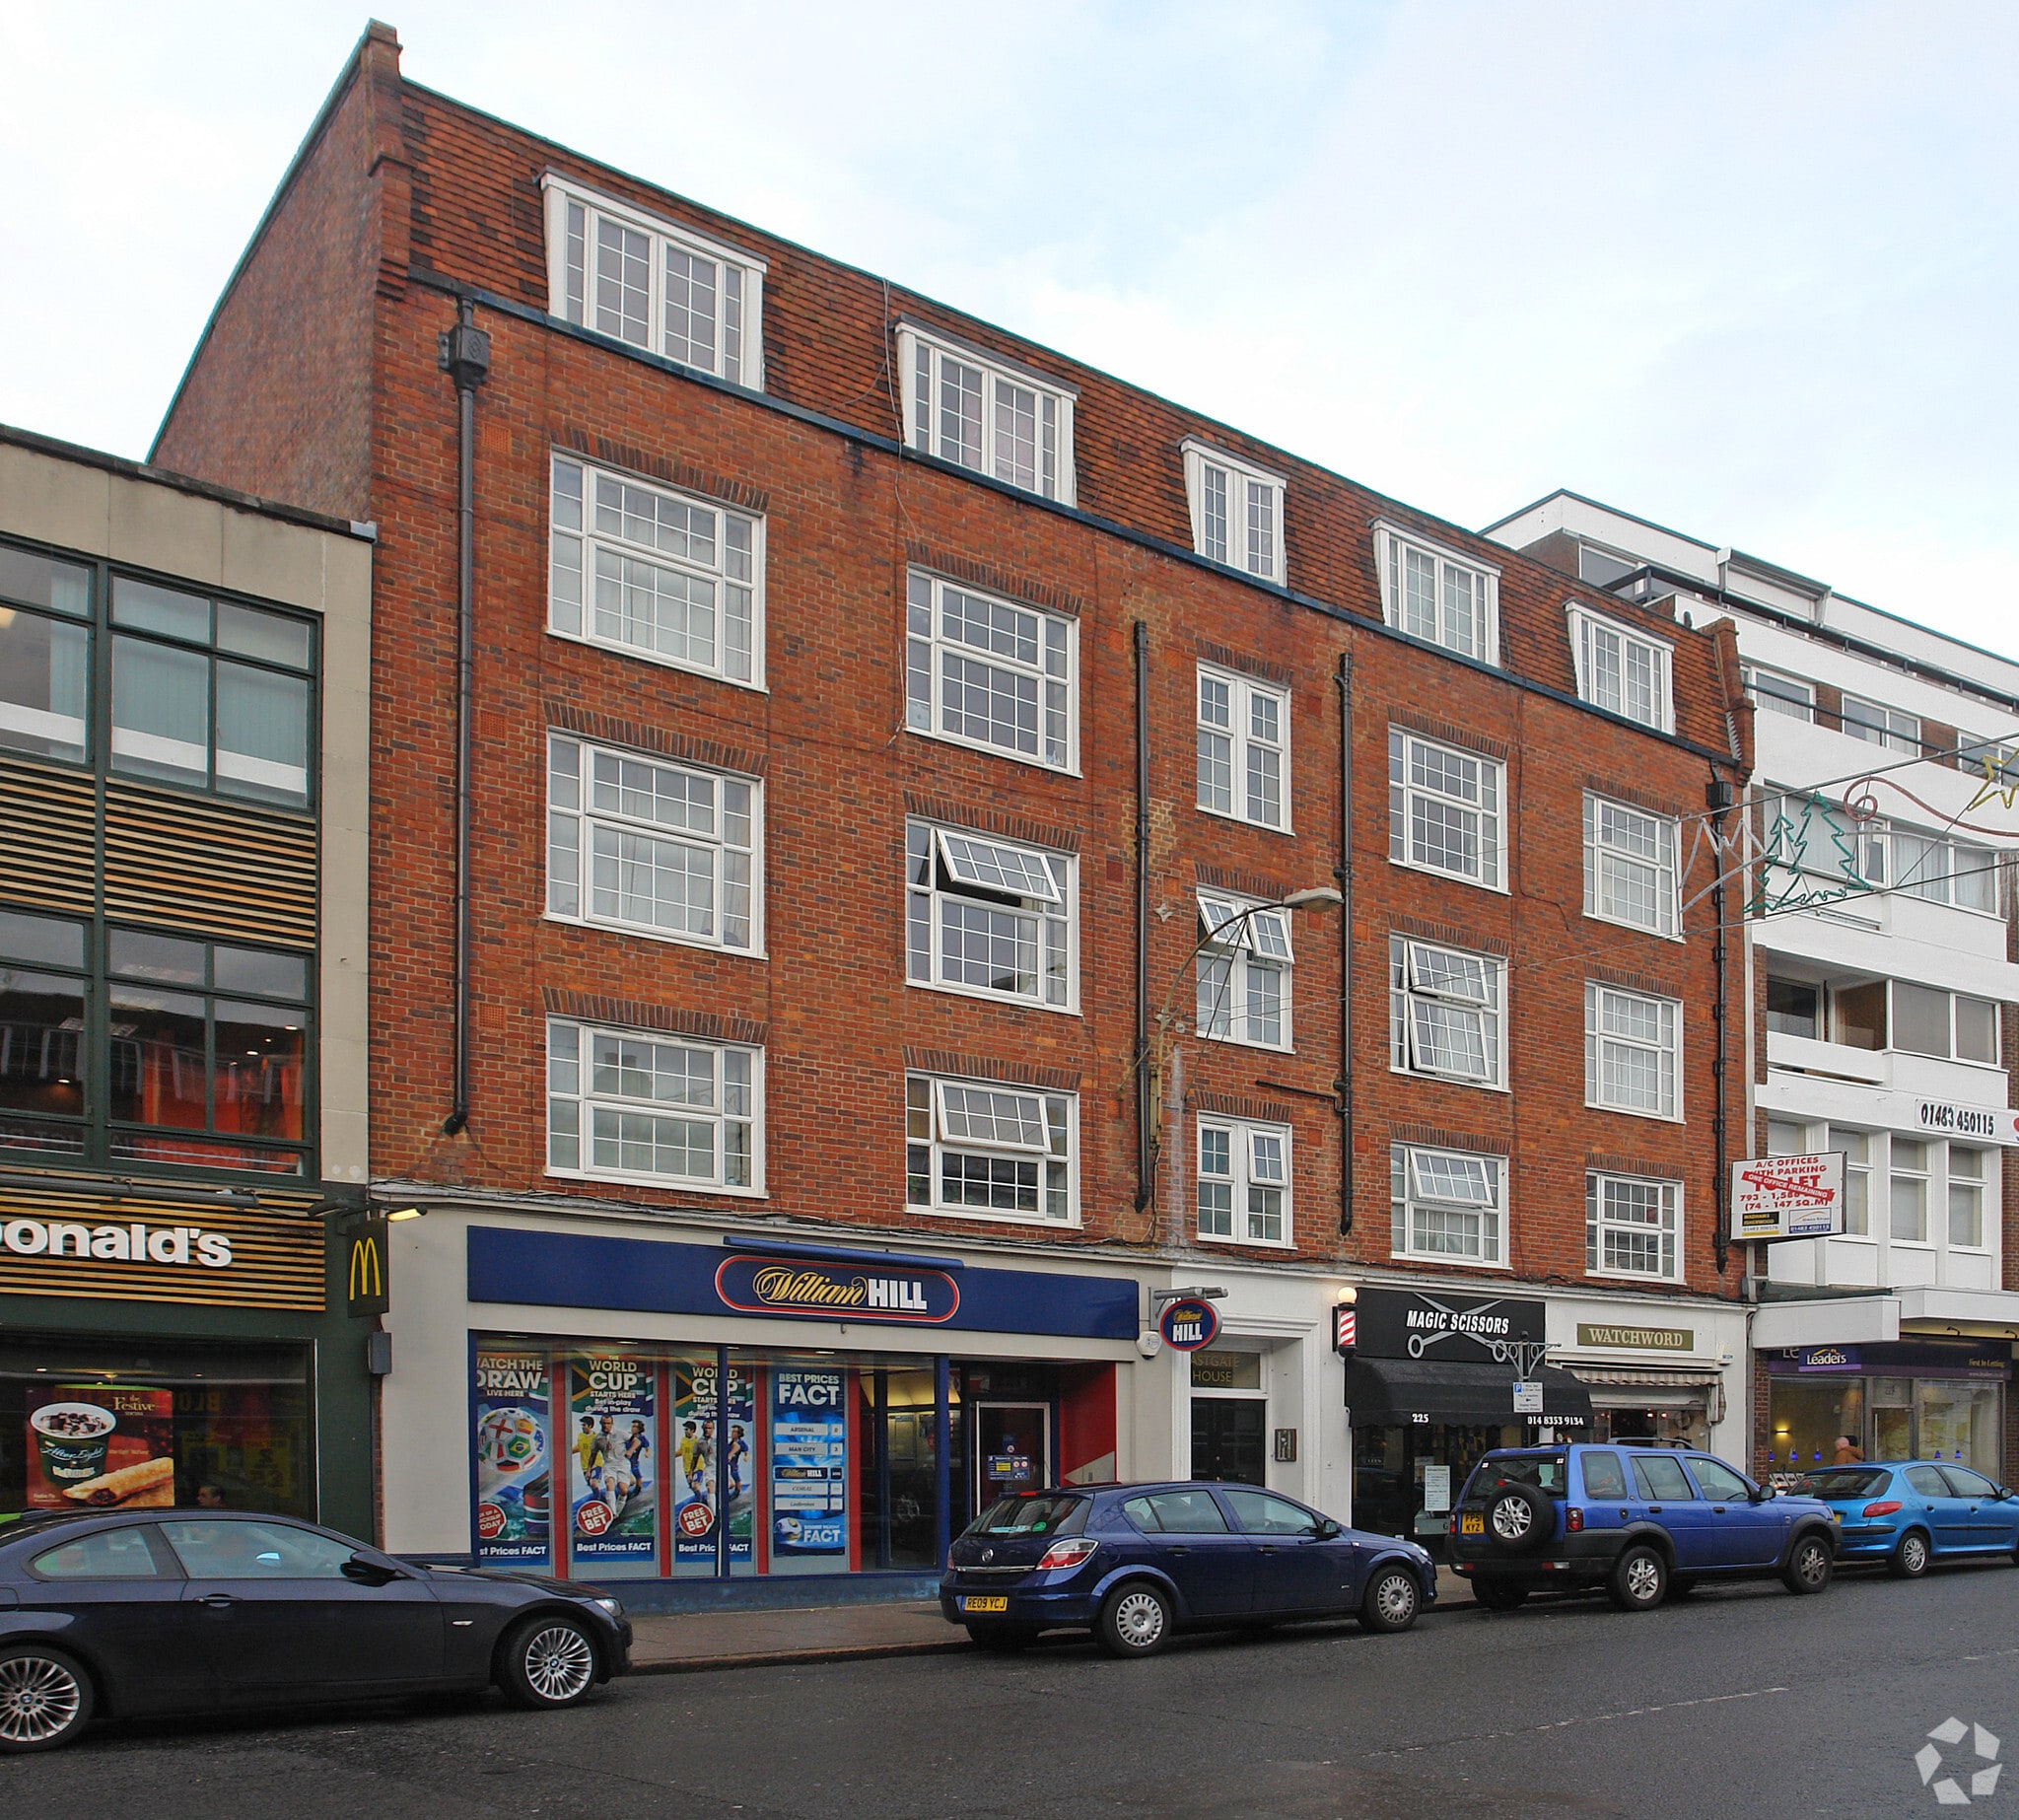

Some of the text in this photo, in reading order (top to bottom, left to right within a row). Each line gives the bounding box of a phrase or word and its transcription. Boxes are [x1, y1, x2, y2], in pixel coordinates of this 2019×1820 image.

[1920, 1103, 1994, 1135] 01483 450115
[1776, 1156, 1819, 1166] OFFICES
[1777, 1164, 1827, 1175] PARKING
[1764, 1178, 1787, 1189] OFFICE
[1788, 1183, 1829, 1198] REMAINING
[0, 1220, 233, 1268] onald's
[753, 1266, 928, 1310] William HILL
[1406, 1309, 1509, 1335] MAGIC SCISSORS
[1173, 1323, 1203, 1342] HILL
[1588, 1328, 1684, 1347] WATCHWORD
[519, 1359, 544, 1371] THE
[589, 1360, 638, 1372] WORLD
[1807, 1353, 1846, 1365] Leaders
[589, 1371, 638, 1390] CUP
[779, 1372, 840, 1385] BEST PRICES
[1193, 1369, 1232, 1382] HOUSE
[779, 1383, 840, 1406] FACT
[113, 1396, 156, 1411] Festive
[1412, 1414, 1584, 1426] 225 014 8353 9134
[806, 1469, 822, 1478] HILL
[580, 1505, 604, 1520] FREE
[682, 1506, 706, 1521] FREE
[480, 1519, 501, 1530] ODAY
[584, 1514, 607, 1530] BET
[685, 1515, 708, 1532] BET
[803, 1529, 841, 1543] FACT
[490, 1547, 520, 1556] Prices
[522, 1546, 546, 1555] FACT
[577, 1542, 652, 1552] Best Prices FACT
[678, 1544, 698, 1553] Best
[967, 1597, 987, 1609] RE09
